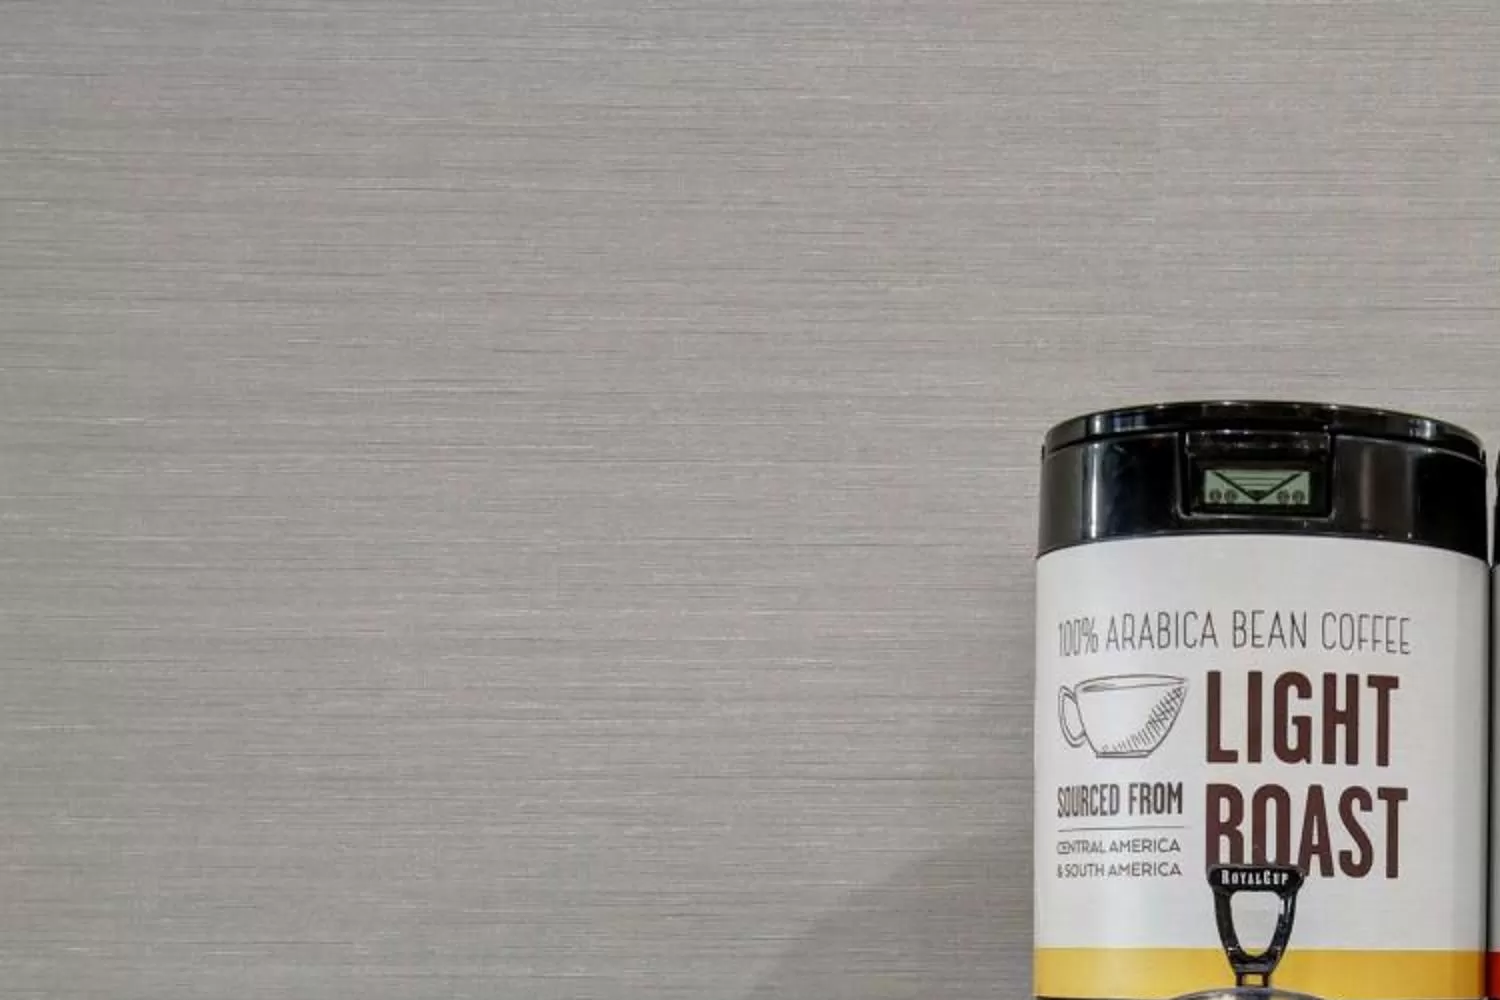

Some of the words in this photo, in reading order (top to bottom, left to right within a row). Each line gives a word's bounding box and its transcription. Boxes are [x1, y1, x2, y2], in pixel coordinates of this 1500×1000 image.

[1057, 616, 1099, 657] 100%
[1105, 609, 1219, 652] ARABICA
[1232, 609, 1308, 649] BEAN
[1321, 611, 1412, 655] COFFEE
[1206, 670, 1399, 766] LIGHT
[1057, 783, 1120, 818] SOURCED
[1128, 781, 1184, 816] FROM
[1109, 838, 1182, 853] AMERICA
[1205, 783, 1409, 879] ROAST
[1107, 862, 1183, 878] AMERICA
